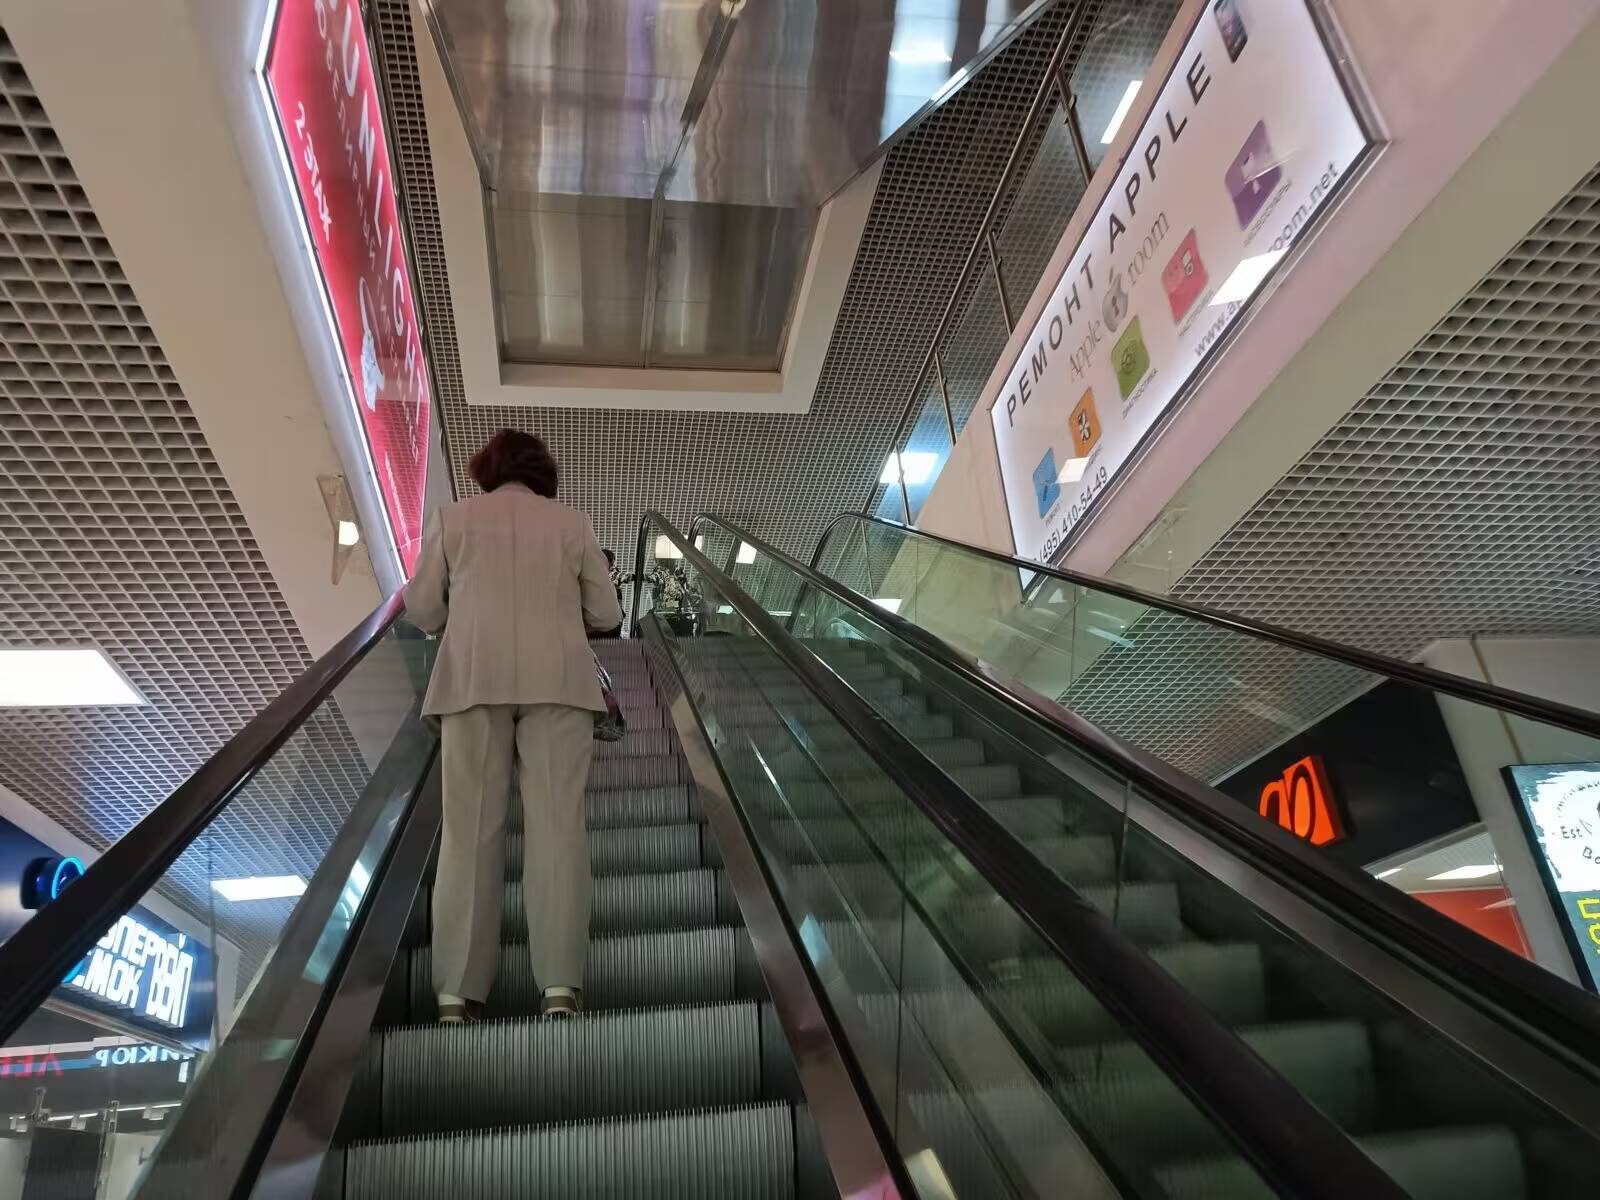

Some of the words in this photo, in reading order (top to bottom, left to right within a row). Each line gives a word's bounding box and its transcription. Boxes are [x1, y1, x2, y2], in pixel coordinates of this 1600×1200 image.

[293, 100, 306, 136] 2
[302, 134, 334, 244] ЭТАЖ
[330, 0, 423, 430] UNLIGHT
[1005, 254, 1097, 427] РЕМОНТ
[1107, 54, 1211, 252] APPLE
[1067, 314, 1104, 386] Apple
[1126, 211, 1169, 283] room
[1039, 529, 1061, 564] (495)
[1063, 466, 1108, 533] 410-54-49
